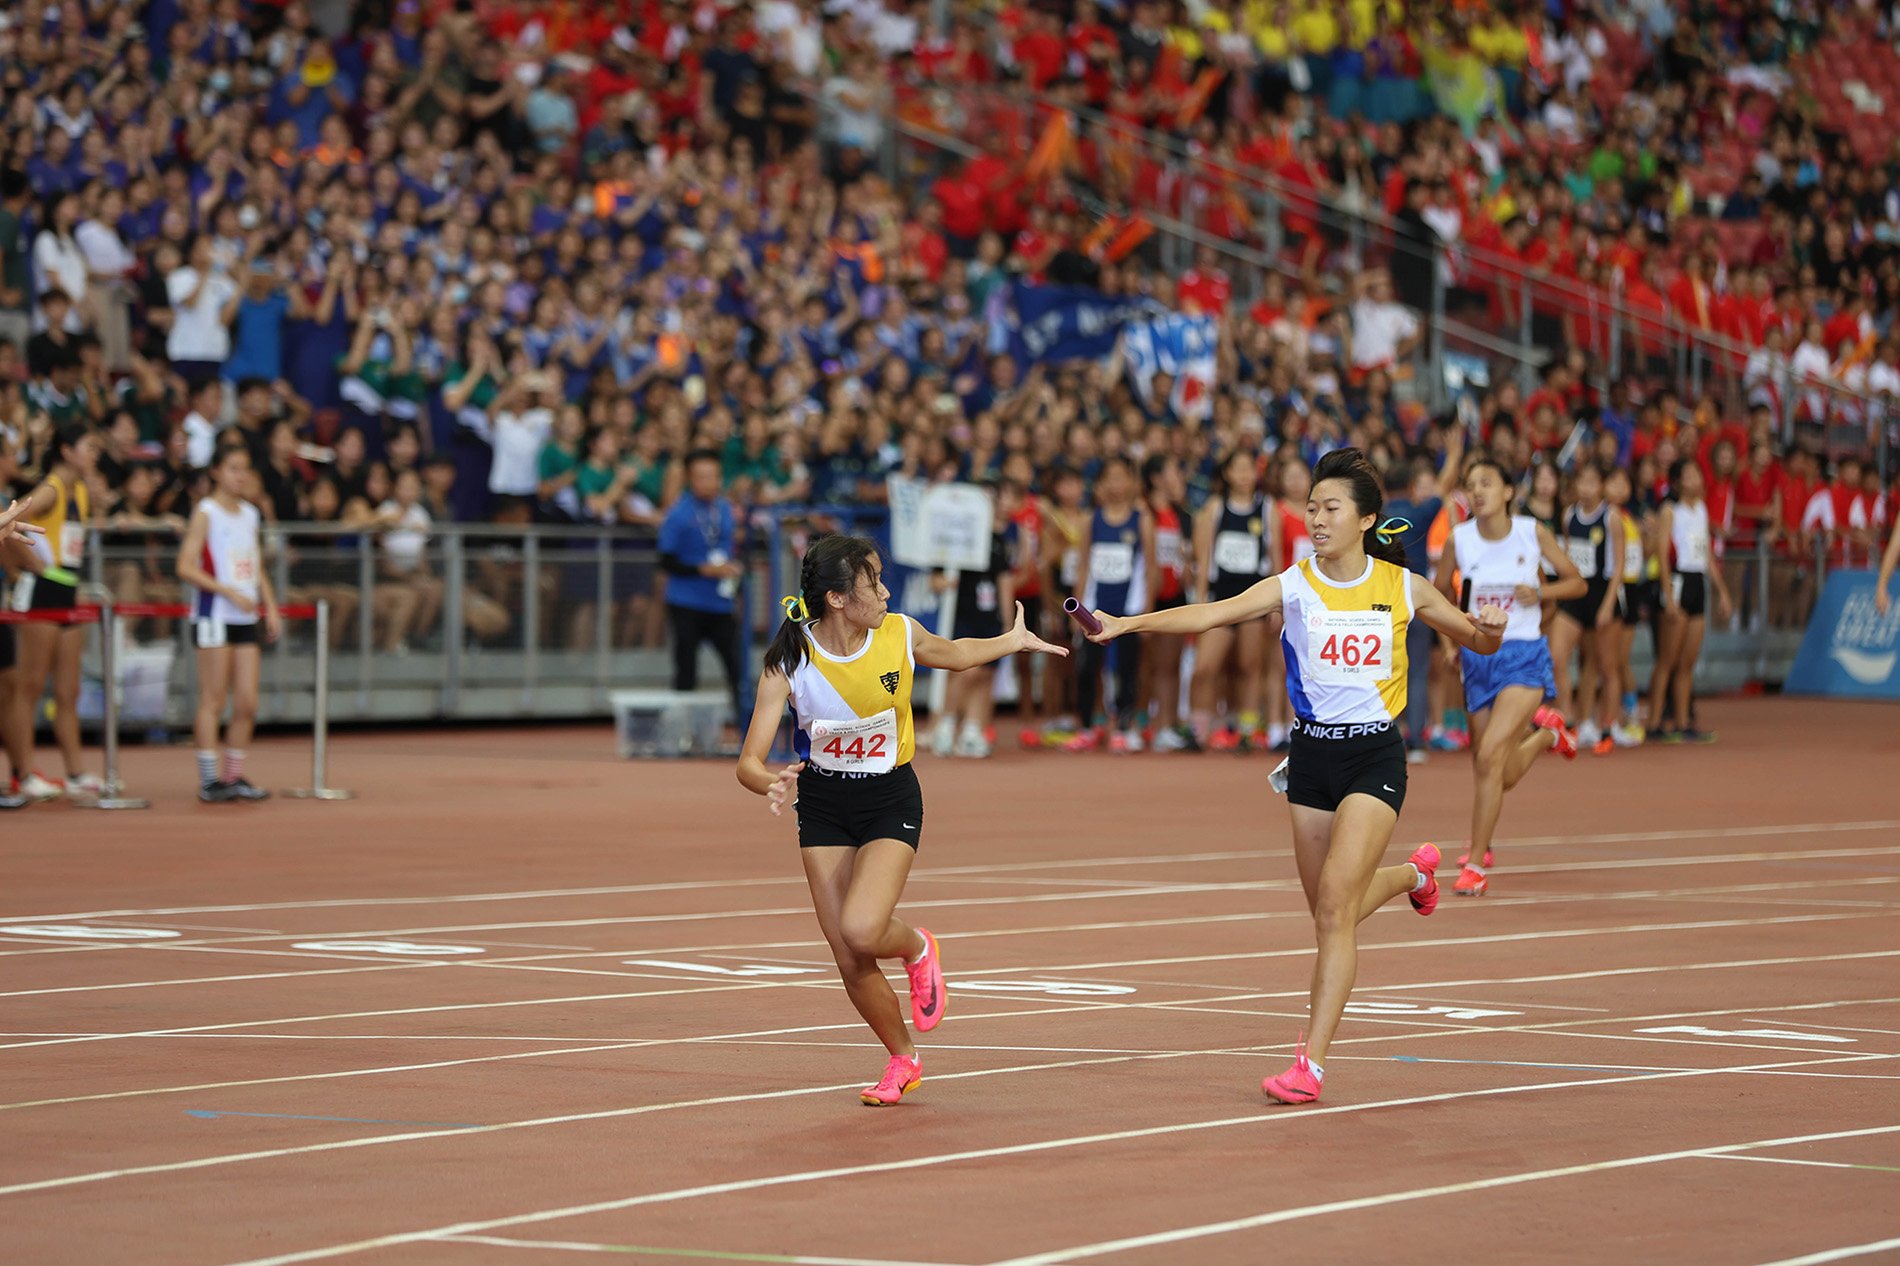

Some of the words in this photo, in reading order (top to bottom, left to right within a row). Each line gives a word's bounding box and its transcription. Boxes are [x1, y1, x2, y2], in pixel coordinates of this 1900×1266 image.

[1319, 634, 1382, 666] 462
[1303, 724, 1346, 740] NIKE
[1348, 721, 1390, 738] PRO
[822, 733, 887, 760] 442
[1633, 1025, 1858, 1043] 4
